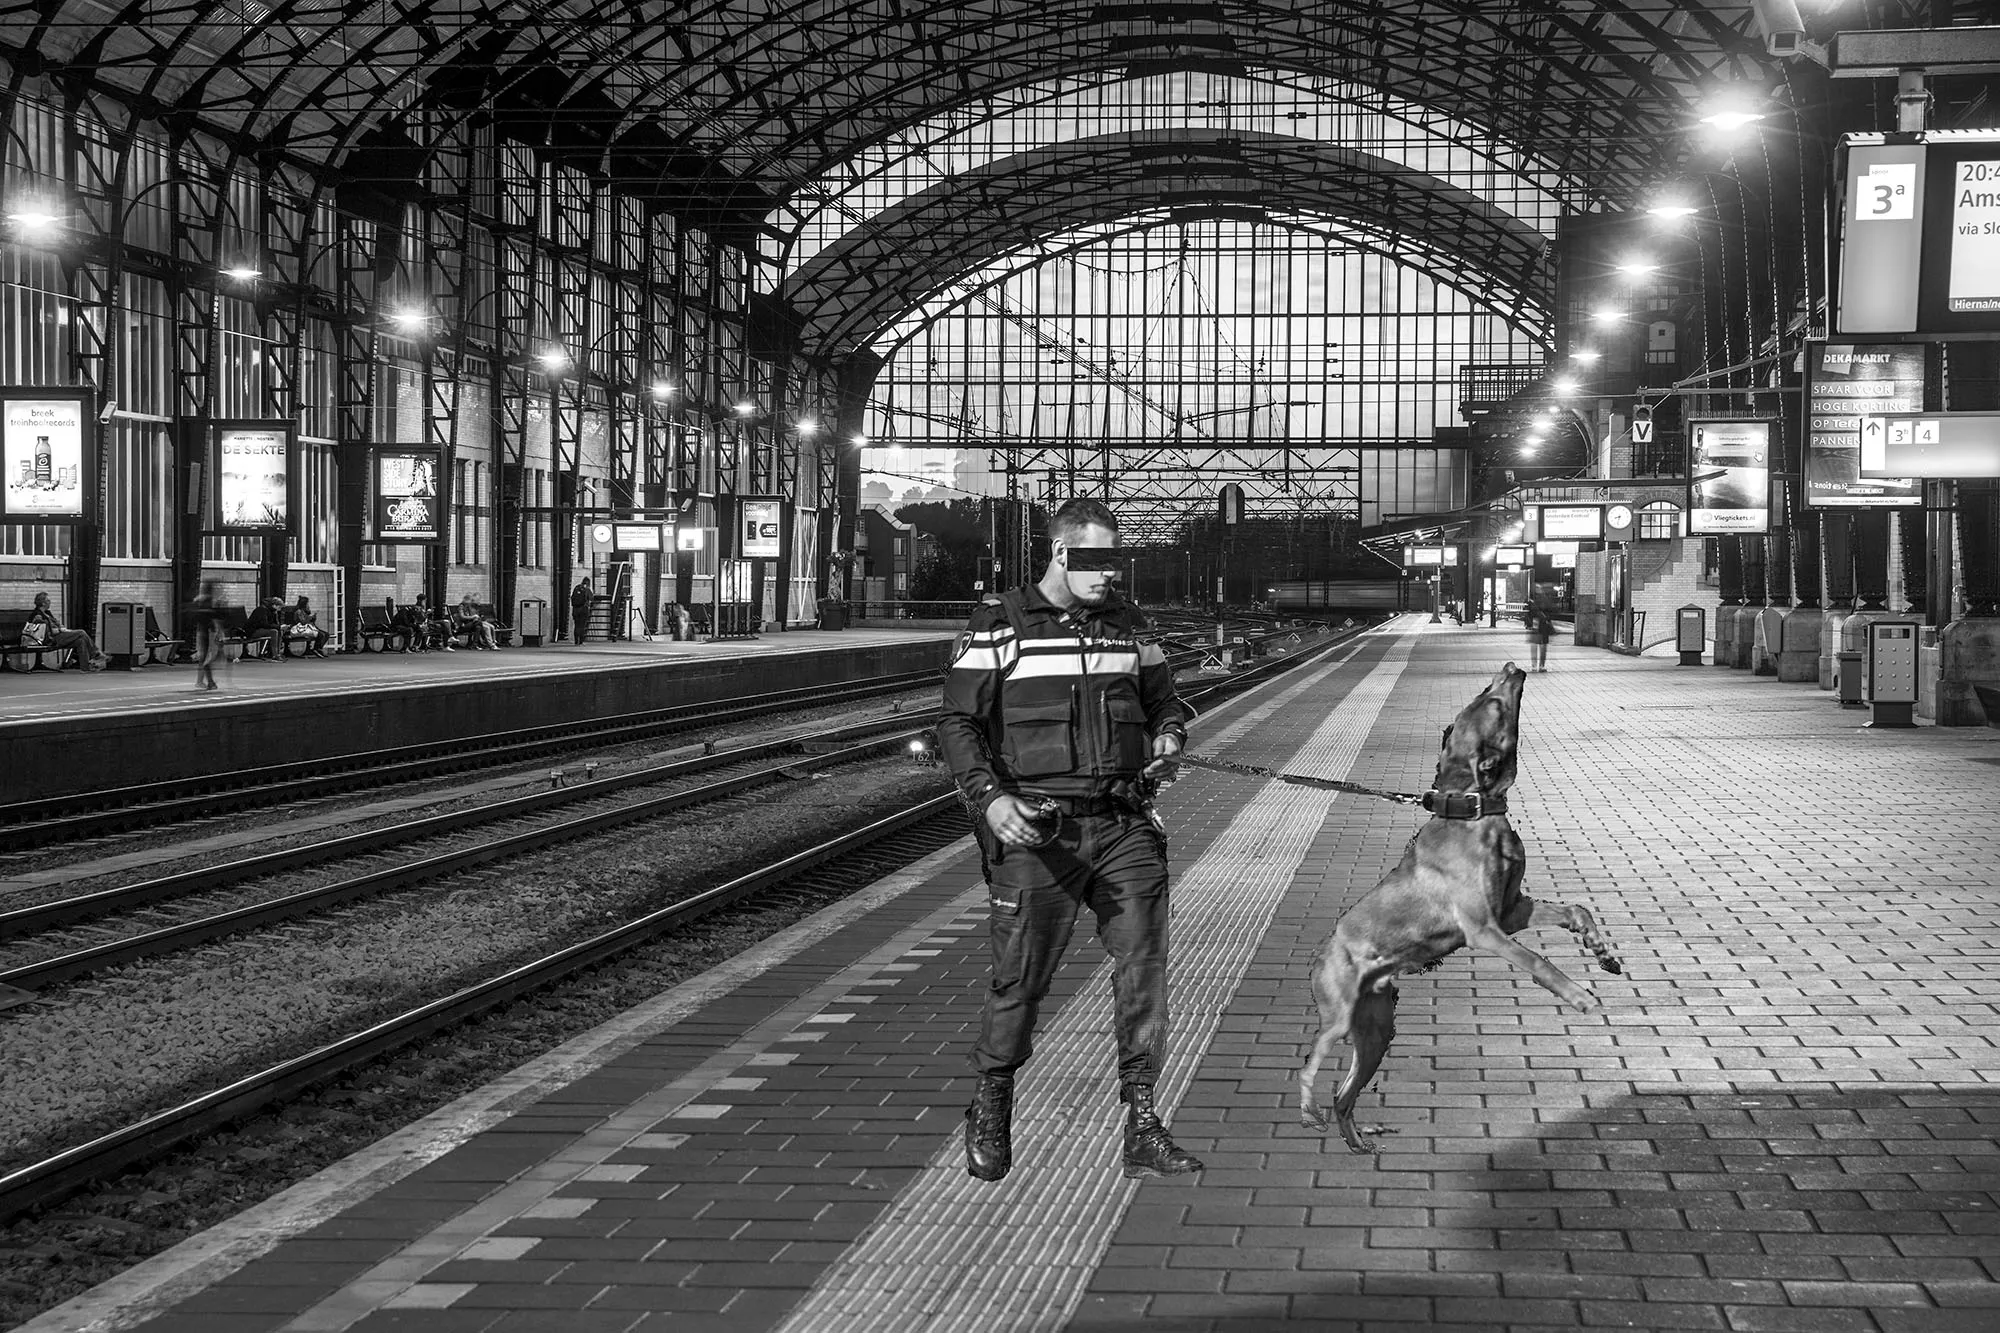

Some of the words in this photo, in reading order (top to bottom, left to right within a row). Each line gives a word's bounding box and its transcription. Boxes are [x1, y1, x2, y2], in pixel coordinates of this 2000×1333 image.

[1959, 222, 1979, 235] via
[1823, 354, 1891, 363] DEKAMARKT
[1813, 385, 1851, 394] SPAAR
[1856, 385, 1891, 394] VOOR
[1813, 402, 1848, 411] HOGE
[1852, 402, 1907, 412] KORTING
[31, 409, 55, 417] breek
[1812, 419, 1829, 428] OP
[1832, 419, 1860, 428] Tefa
[1635, 423, 1651, 440] V
[1922, 429, 1932, 441] 4
[1812, 436, 1860, 445] PANNEN
[223, 445, 241, 454] DE
[244, 445, 285, 455] SEKTE
[383, 459, 405, 469] WEST
